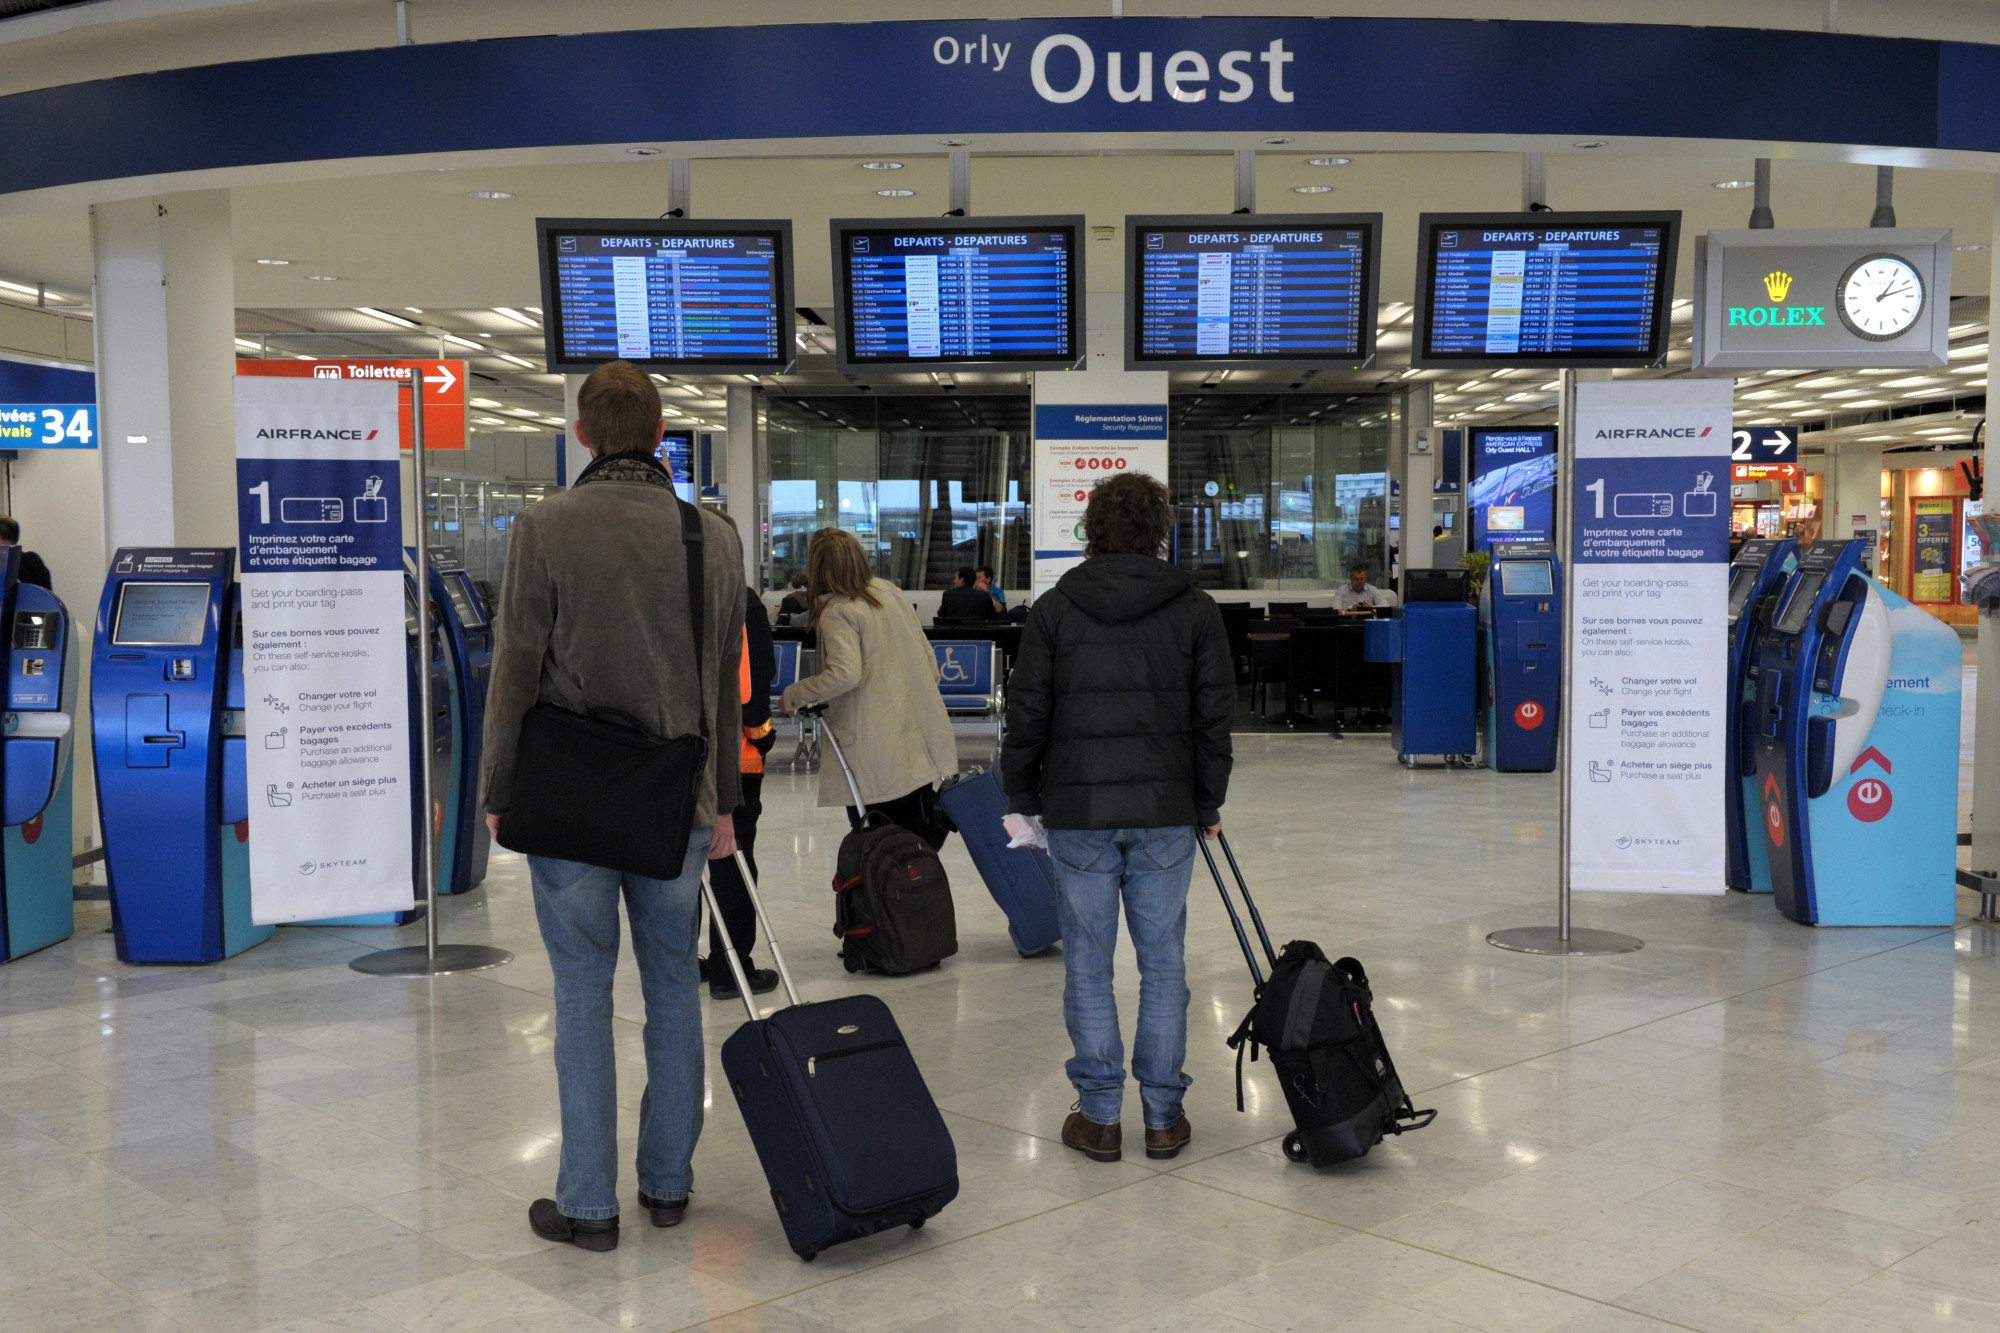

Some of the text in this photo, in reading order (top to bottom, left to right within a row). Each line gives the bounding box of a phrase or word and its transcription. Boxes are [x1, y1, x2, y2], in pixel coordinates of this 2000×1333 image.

[933, 34, 1294, 104] Orly Ouest
[894, 235, 1028, 246] DEPARTS DEPARTURES
[1188, 233, 1323, 243] DEPARTS DEPARTURES
[1483, 231, 1620, 241] DEPARTS DEPARTURES
[601, 238, 651, 248] DEPARTS
[662, 239, 735, 248] DEPARTURES
[1728, 307, 1825, 326] ROLEX
[347, 365, 411, 378] Toilettes
[1075, 415, 1136, 424] Réglementation
[42, 409, 93, 444] 34
[256, 428, 362, 440] AIRFRANCE
[1595, 428, 1696, 439] AIRFRANCE
[1732, 431, 1752, 460] 2
[249, 481, 270, 524] 1
[1586, 478, 1604, 518] 1
[1584, 529, 1628, 538] Imprimez
[1919, 524, 1928, 537] 3
[249, 534, 354, 545] Imprimez votre carte
[1583, 538, 1666, 548] d'embarquement
[250, 545, 338, 555] d'embarquement
[1622, 548, 1664, 558] étiquette
[1667, 548, 1704, 558] bagage
[250, 555, 378, 566] et votre étiquette bagage
[1582, 579, 1688, 588] Get your boarding-pass
[251, 588, 363, 599] Get your boarding-pass
[1602, 589, 1622, 599] print
[1625, 590, 1644, 598] your
[1646, 590, 1660, 598] tag
[251, 600, 336, 610] and print your tag
[253, 630, 268, 638] Sur
[290, 629, 322, 637] bornes
[348, 628, 380, 637] pouvez
[1582, 628, 1626, 636] également
[253, 641, 301, 651] également
[1664, 638, 1692, 646] kiosks,
[253, 653, 266, 661] On
[294, 651, 340, 659] self-service
[342, 650, 369, 658] kiosks,
[253, 664, 269, 673] you
[1621, 677, 1658, 686] Changer
[299, 692, 336, 701] Changer
[339, 690, 361, 698] votre
[1621, 688, 1652, 697] Change
[1673, 688, 1692, 696] flight
[299, 701, 372, 712] Change your flight
[1621, 709, 1646, 717] Payer
[300, 726, 326, 735] Payer
[346, 722, 392, 731] excédents
[1621, 719, 1658, 728] bagages
[300, 736, 339, 746] bagages
[1620, 740, 1655, 749] baggage
[300, 747, 339, 756] Purchase
[353, 743, 392, 752] additional
[300, 756, 379, 768] baggage allowance
[1620, 761, 1654, 769] Acheter
[1670, 761, 1692, 771] siège
[1694, 762, 1712, 771] plus
[301, 781, 336, 789] Acheter
[352, 778, 376, 786] siège
[378, 776, 397, 785] plus
[301, 791, 340, 800] Purchase
[369, 788, 386, 796] plus
[320, 860, 366, 868] SKYTEAM
